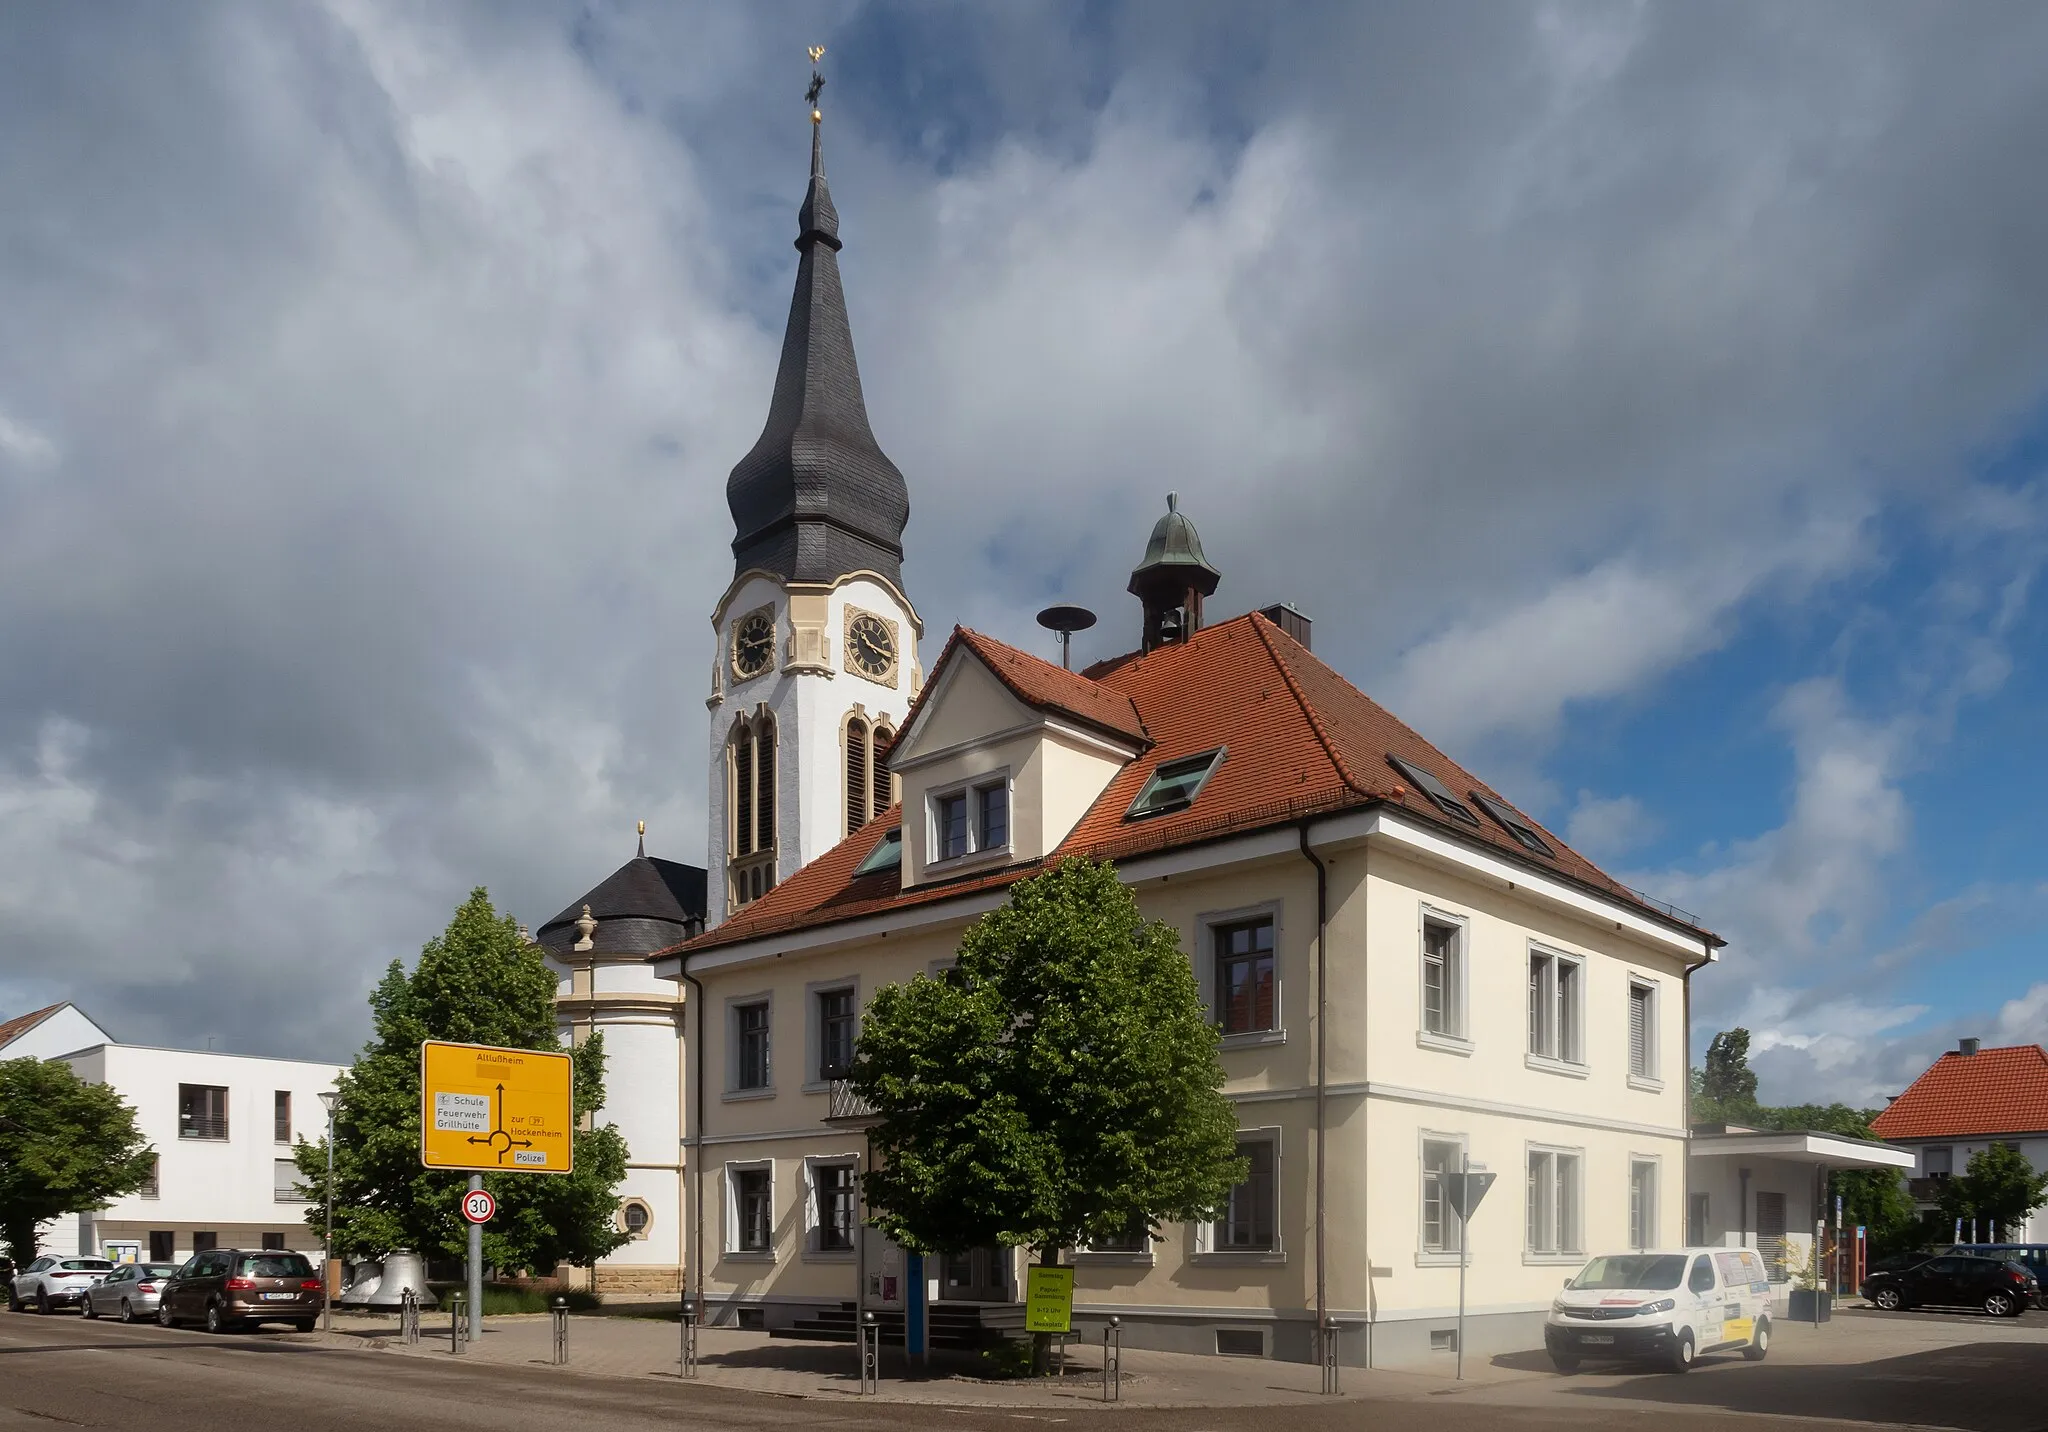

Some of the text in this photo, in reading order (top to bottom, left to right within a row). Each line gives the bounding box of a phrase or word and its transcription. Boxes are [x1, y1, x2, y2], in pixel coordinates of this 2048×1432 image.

[476, 1053, 524, 1065] Altlußheim
[454, 1096, 484, 1106] Schule
[437, 1108, 487, 1119] Feuerwehr
[437, 1119, 480, 1130] Grillhütte
[511, 1127, 562, 1138] Hockenheim
[516, 1153, 545, 1162] Polizei
[470, 1199, 488, 1213] 30
[1038, 1272, 1064, 1280] Samstag
